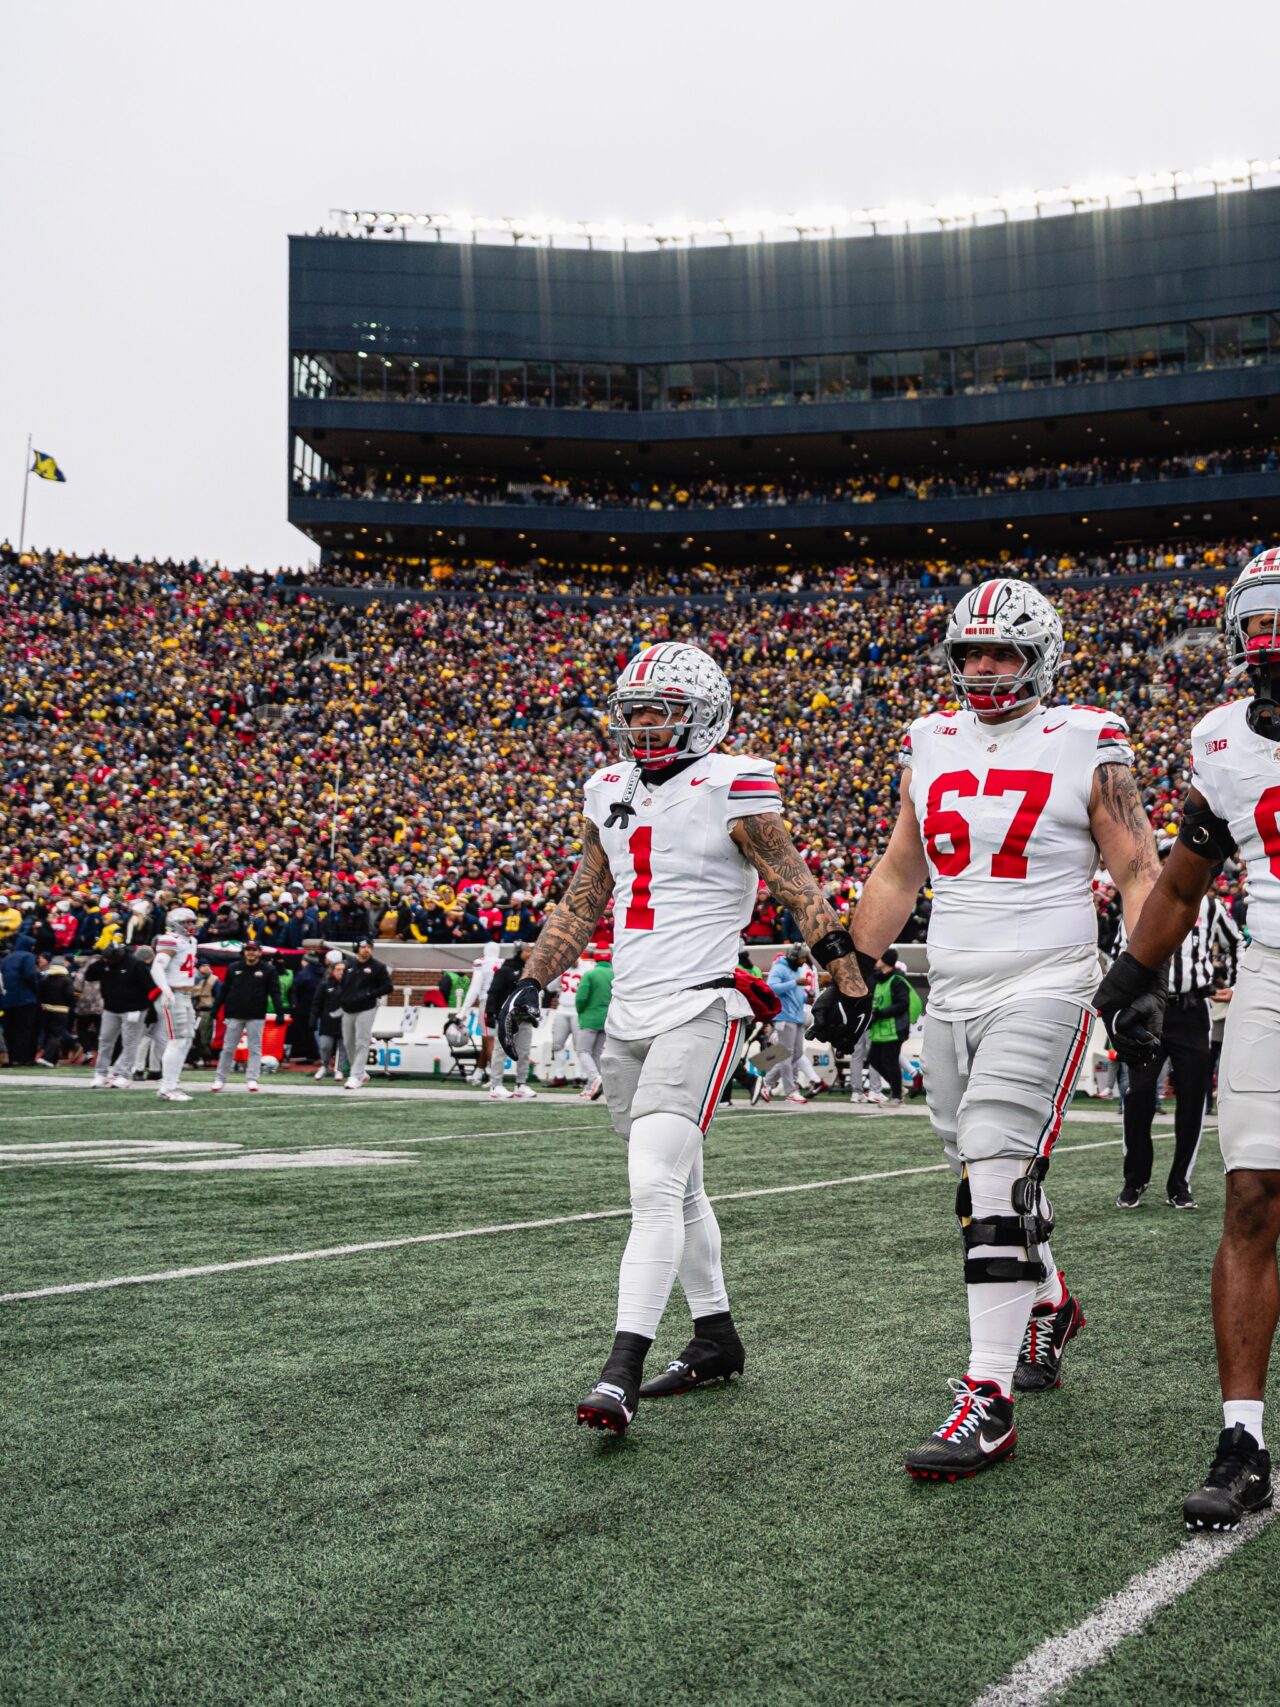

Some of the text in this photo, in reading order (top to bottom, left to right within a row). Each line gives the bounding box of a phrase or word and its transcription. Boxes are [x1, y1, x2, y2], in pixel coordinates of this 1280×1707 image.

[965, 627, 995, 635] OHIO STATE
[923, 768, 1053, 879] 67
[625, 826, 655, 930] 1
